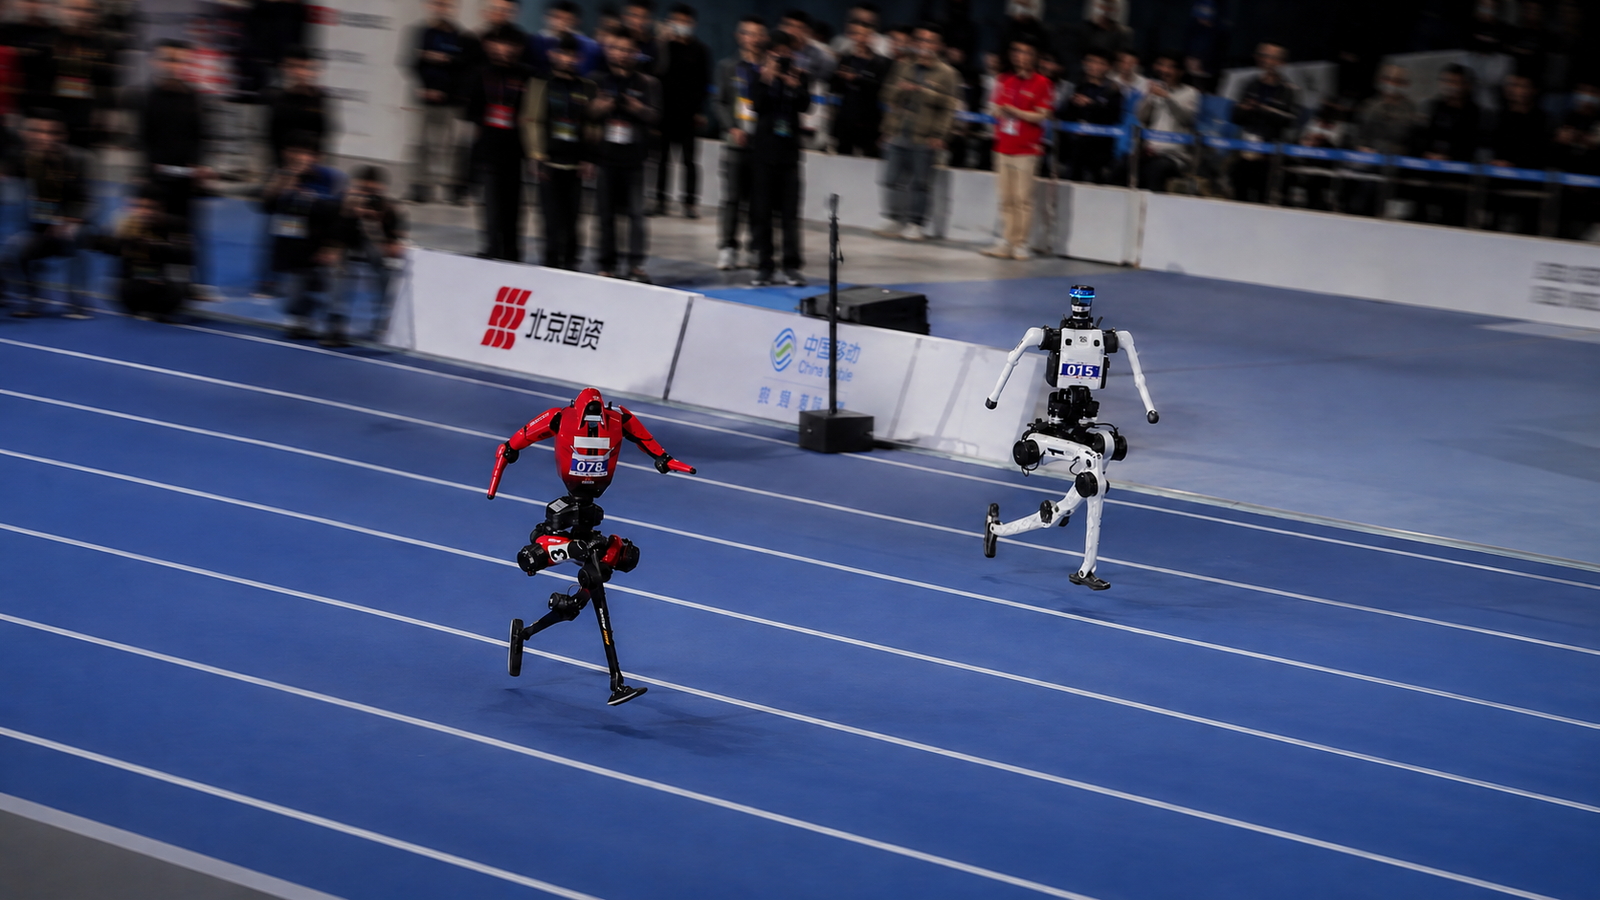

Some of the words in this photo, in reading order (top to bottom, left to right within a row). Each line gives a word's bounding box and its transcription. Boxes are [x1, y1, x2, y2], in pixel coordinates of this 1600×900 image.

[525, 308, 604, 350] 北京国资
[798, 360, 823, 377] China
[1067, 365, 1093, 376] 015
[576, 461, 604, 472] 078
[551, 548, 568, 561] 3
